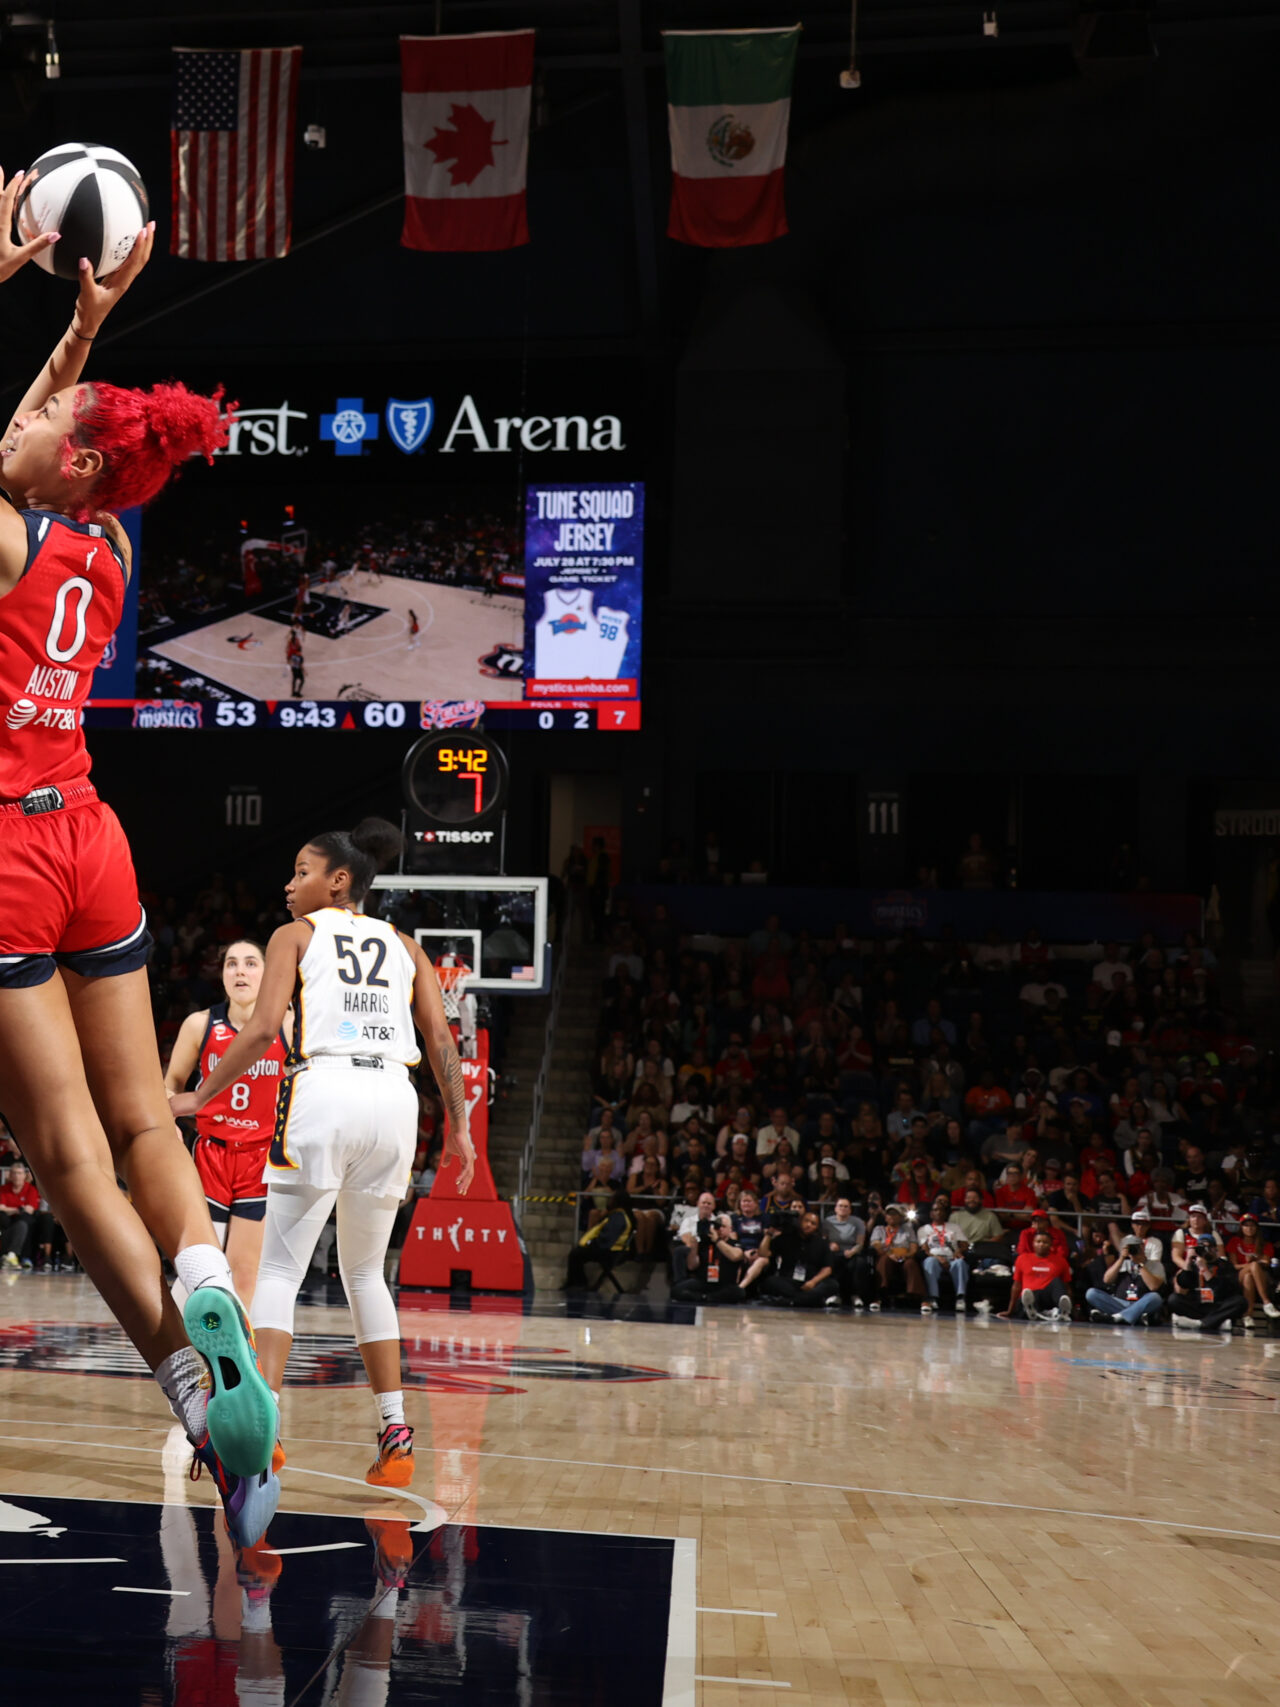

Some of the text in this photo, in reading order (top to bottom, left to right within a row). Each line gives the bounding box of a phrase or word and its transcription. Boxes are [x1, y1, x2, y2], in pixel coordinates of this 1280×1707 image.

[438, 395, 626, 452] Arena
[536, 490, 634, 522] TUNE SQUAD
[554, 523, 615, 551] JERSEY
[533, 556, 560, 567] JULY
[576, 556, 591, 567] AT
[615, 556, 635, 567] PM
[46, 576, 93, 663] 0
[24, 664, 79, 700] AUSTIN
[532, 683, 630, 695] mystics.wnba.com
[216, 702, 256, 726] 53
[280, 707, 336, 728] 9:43
[364, 703, 405, 727] 60
[539, 710, 626, 729] 0 2 7
[438, 749, 488, 772] 9:42
[457, 773, 483, 814] 7
[226, 794, 262, 826] 110
[868, 802, 899, 834] 111
[1214, 810, 1280, 836] STROO
[436, 831, 494, 843] TISSOT
[334, 934, 390, 988] 52
[344, 991, 389, 1014] HARRIS
[230, 1083, 250, 1111] 8
